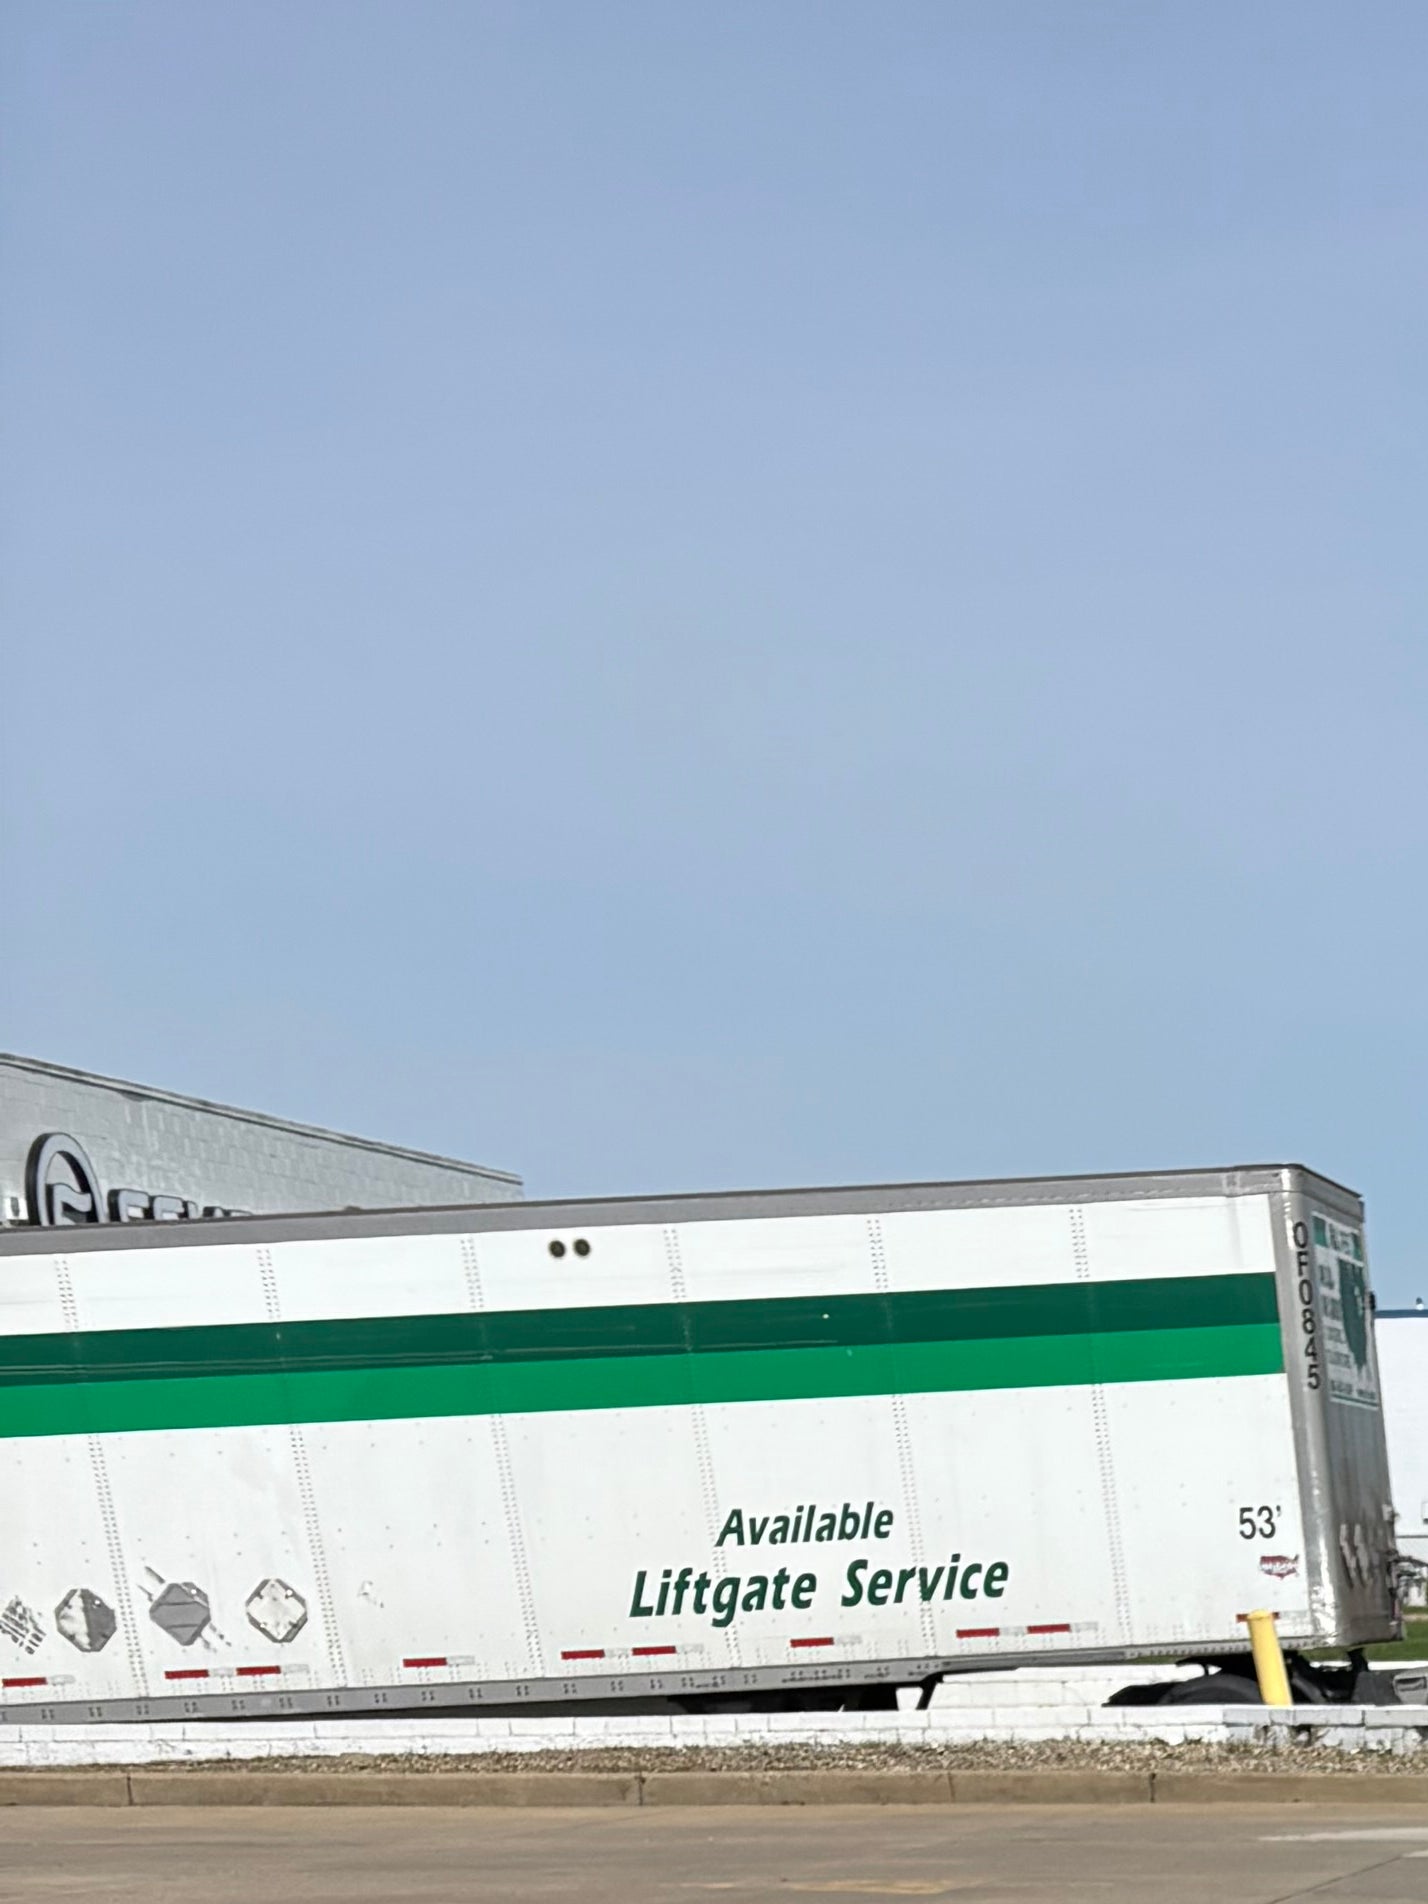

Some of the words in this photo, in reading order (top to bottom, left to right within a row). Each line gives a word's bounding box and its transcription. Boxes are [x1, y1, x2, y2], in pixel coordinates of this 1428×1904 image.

[715, 1501, 894, 1547] Available
[629, 1567, 818, 1628] Liftgate
[840, 1553, 1010, 1608] Service
